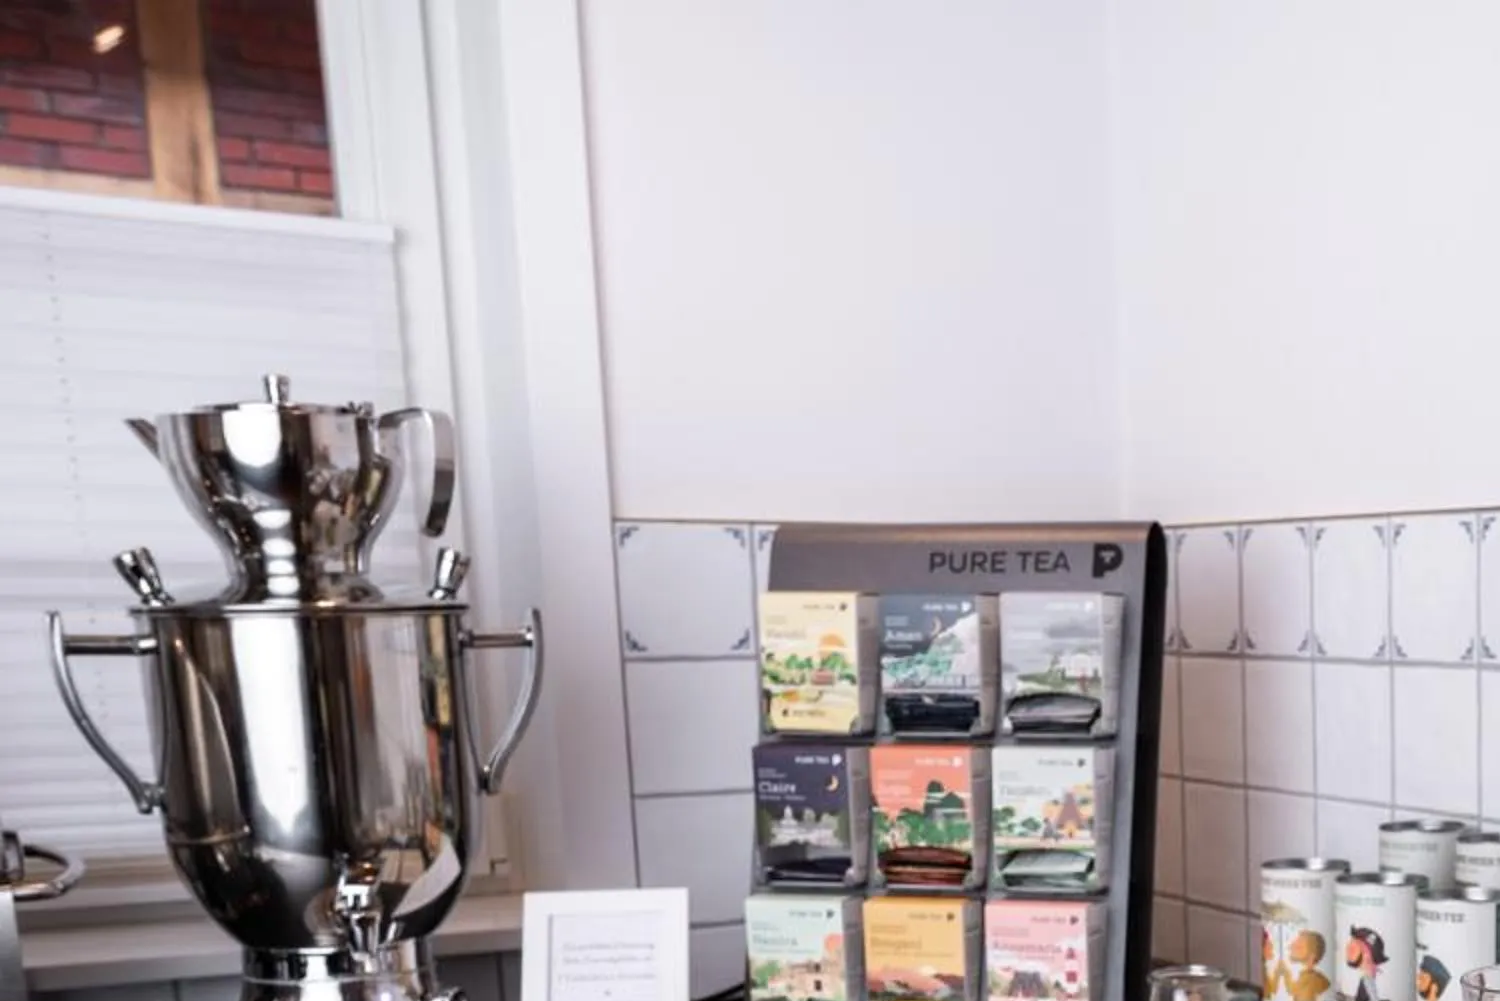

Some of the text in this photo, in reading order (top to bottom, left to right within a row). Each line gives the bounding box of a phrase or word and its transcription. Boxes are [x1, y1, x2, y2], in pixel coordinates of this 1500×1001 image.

[929, 551, 1007, 574] PURE
[1016, 551, 1070, 573] TEA
[759, 781, 797, 794] Claire
